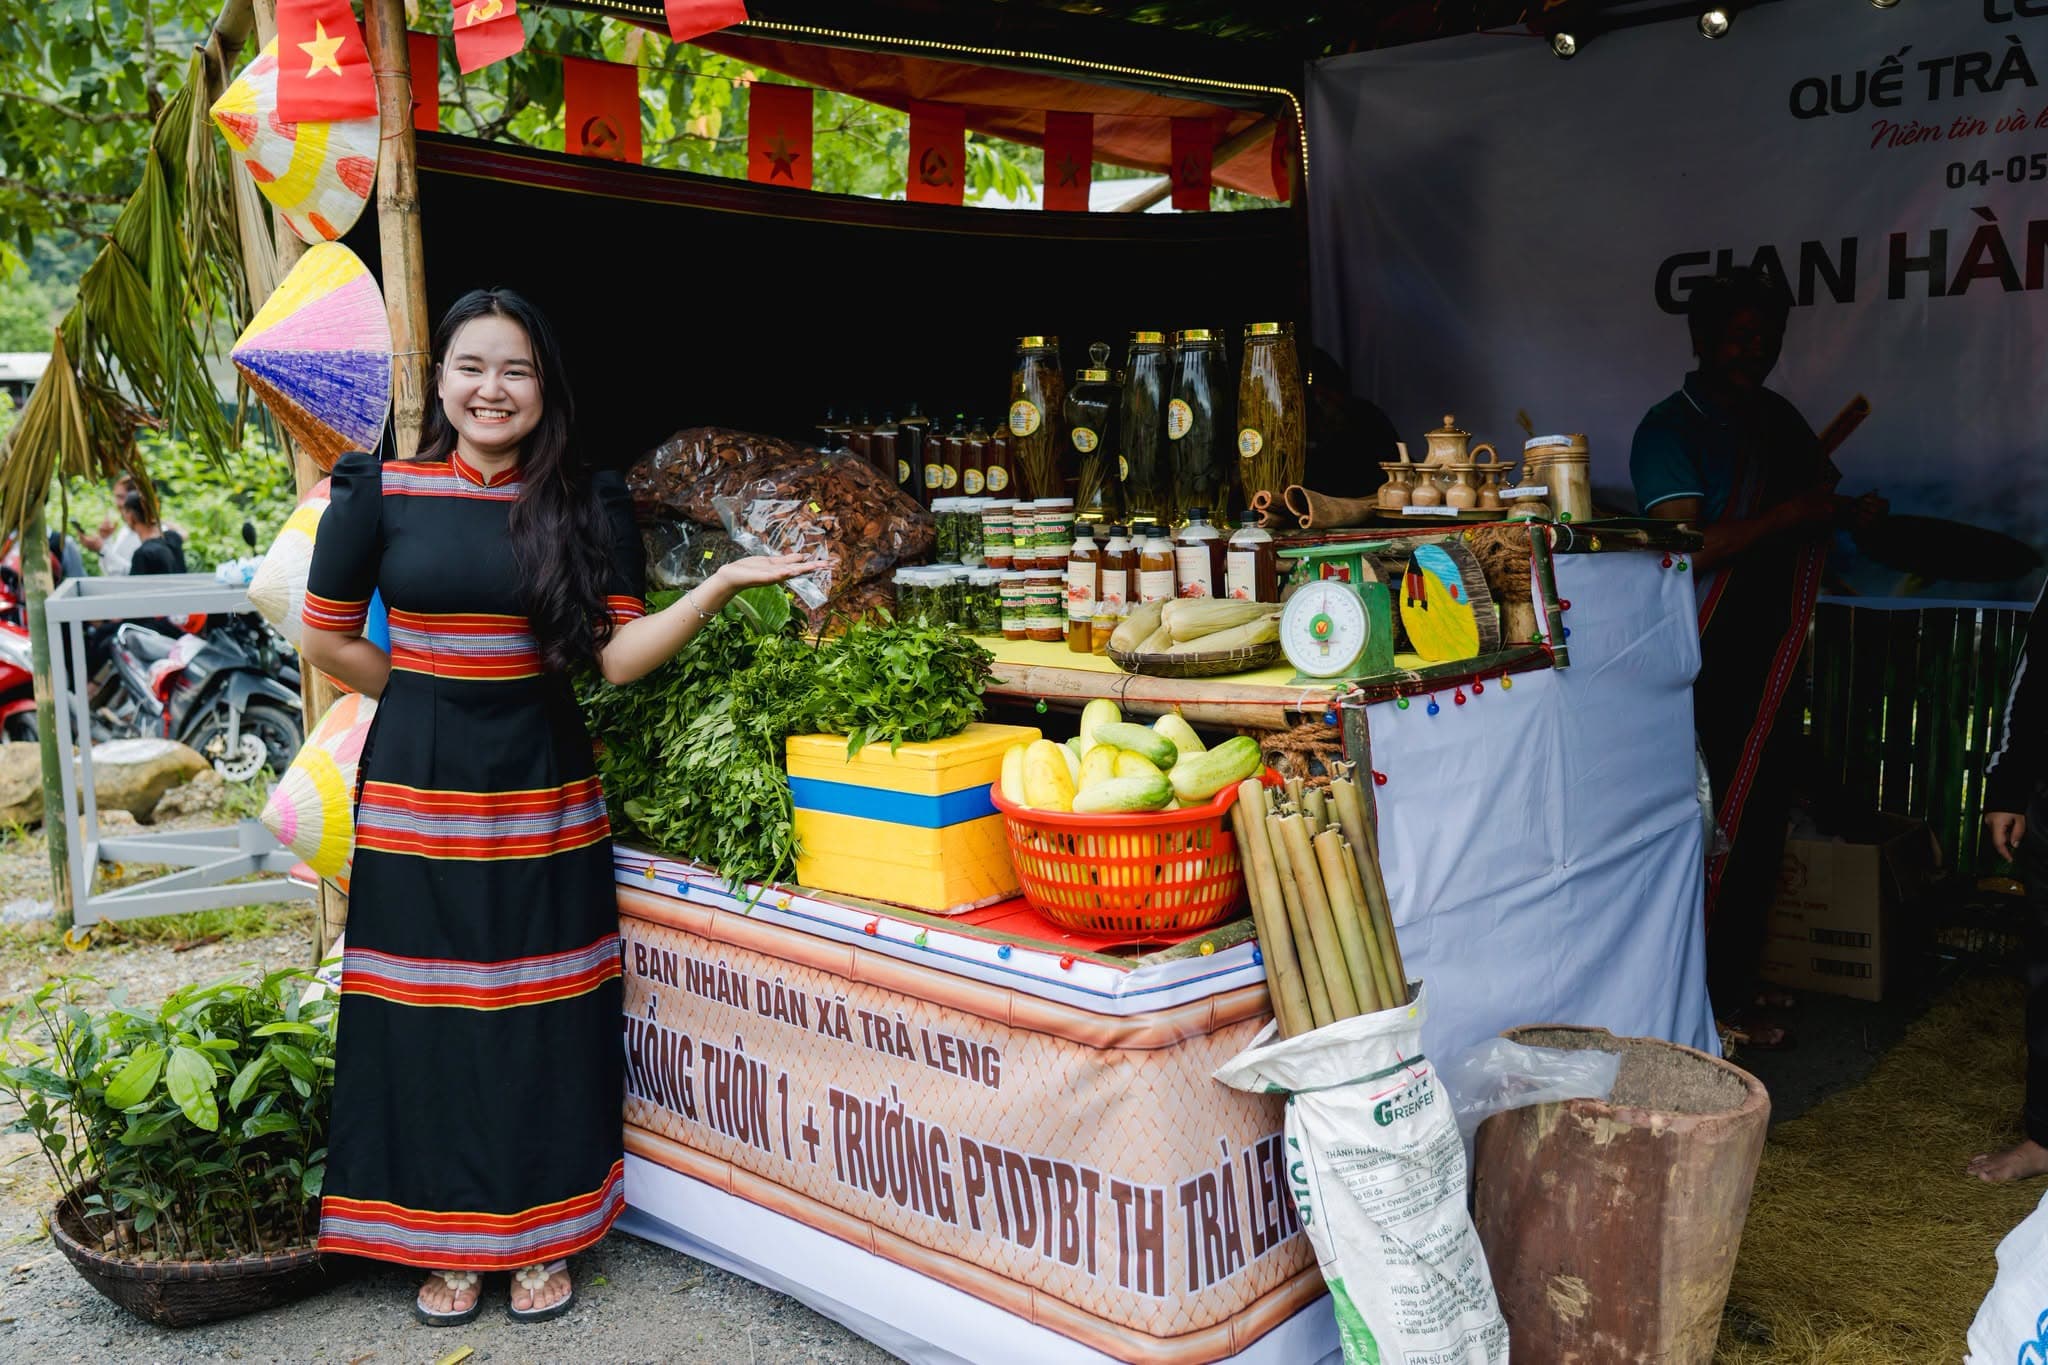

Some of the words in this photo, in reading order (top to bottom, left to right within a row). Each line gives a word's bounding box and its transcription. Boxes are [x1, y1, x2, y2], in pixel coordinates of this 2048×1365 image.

[1789, 45, 1913, 120] QUẾ
[1918, 34, 2039, 102] TRÀ
[1870, 119, 1943, 150] Niềm
[1947, 114, 1987, 139] tin
[1995, 108, 2027, 133] và
[633, 941, 679, 988] BAN
[685, 957, 749, 1011] NHÂN
[756, 977, 809, 1030] DÂN
[815, 995, 854, 1043] XÃ
[858, 1009, 917, 1062] TRÀ
[920, 1027, 1000, 1090] LENG
[701, 1034, 771, 1153] THÔN
[777, 1071, 792, 1161] 1
[802, 1104, 820, 1164] +
[828, 1084, 958, 1225] TRƯỜNG
[959, 1136, 1100, 1276] PTDTBT
[1110, 1179, 1165, 1298] TH
[1179, 1138, 1246, 1293] TRÀ
[1243, 1134, 1298, 1260] LEN
